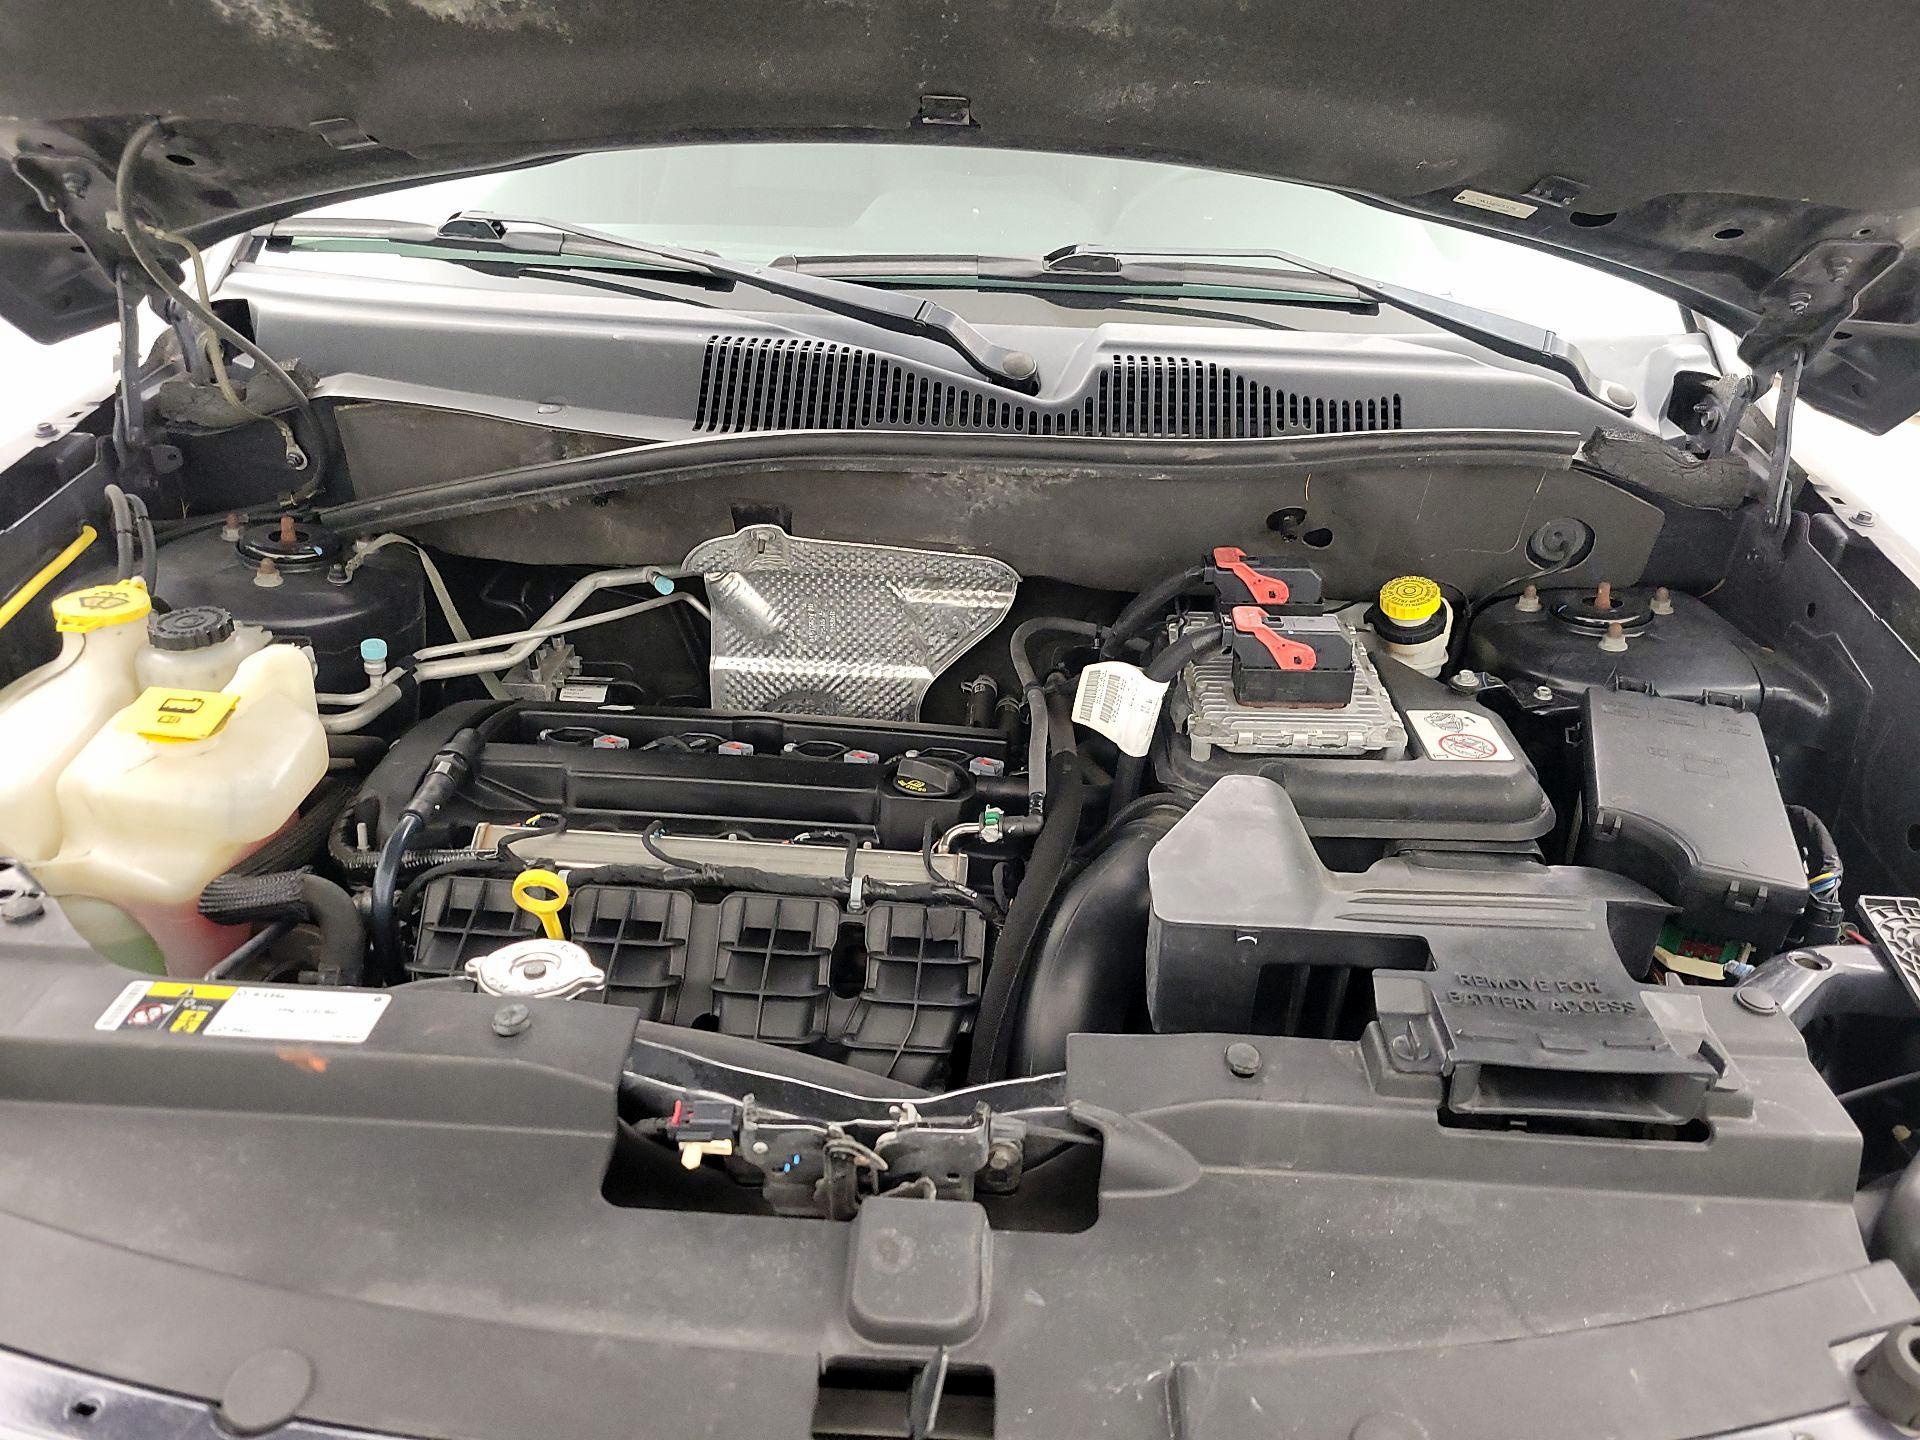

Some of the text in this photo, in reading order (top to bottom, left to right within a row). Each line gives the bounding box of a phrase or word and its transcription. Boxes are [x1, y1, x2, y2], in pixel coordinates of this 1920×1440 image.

[1457, 974, 1602, 994] REMOVE FOR
[1449, 991, 1637, 1013] BATTERY ACCESS
